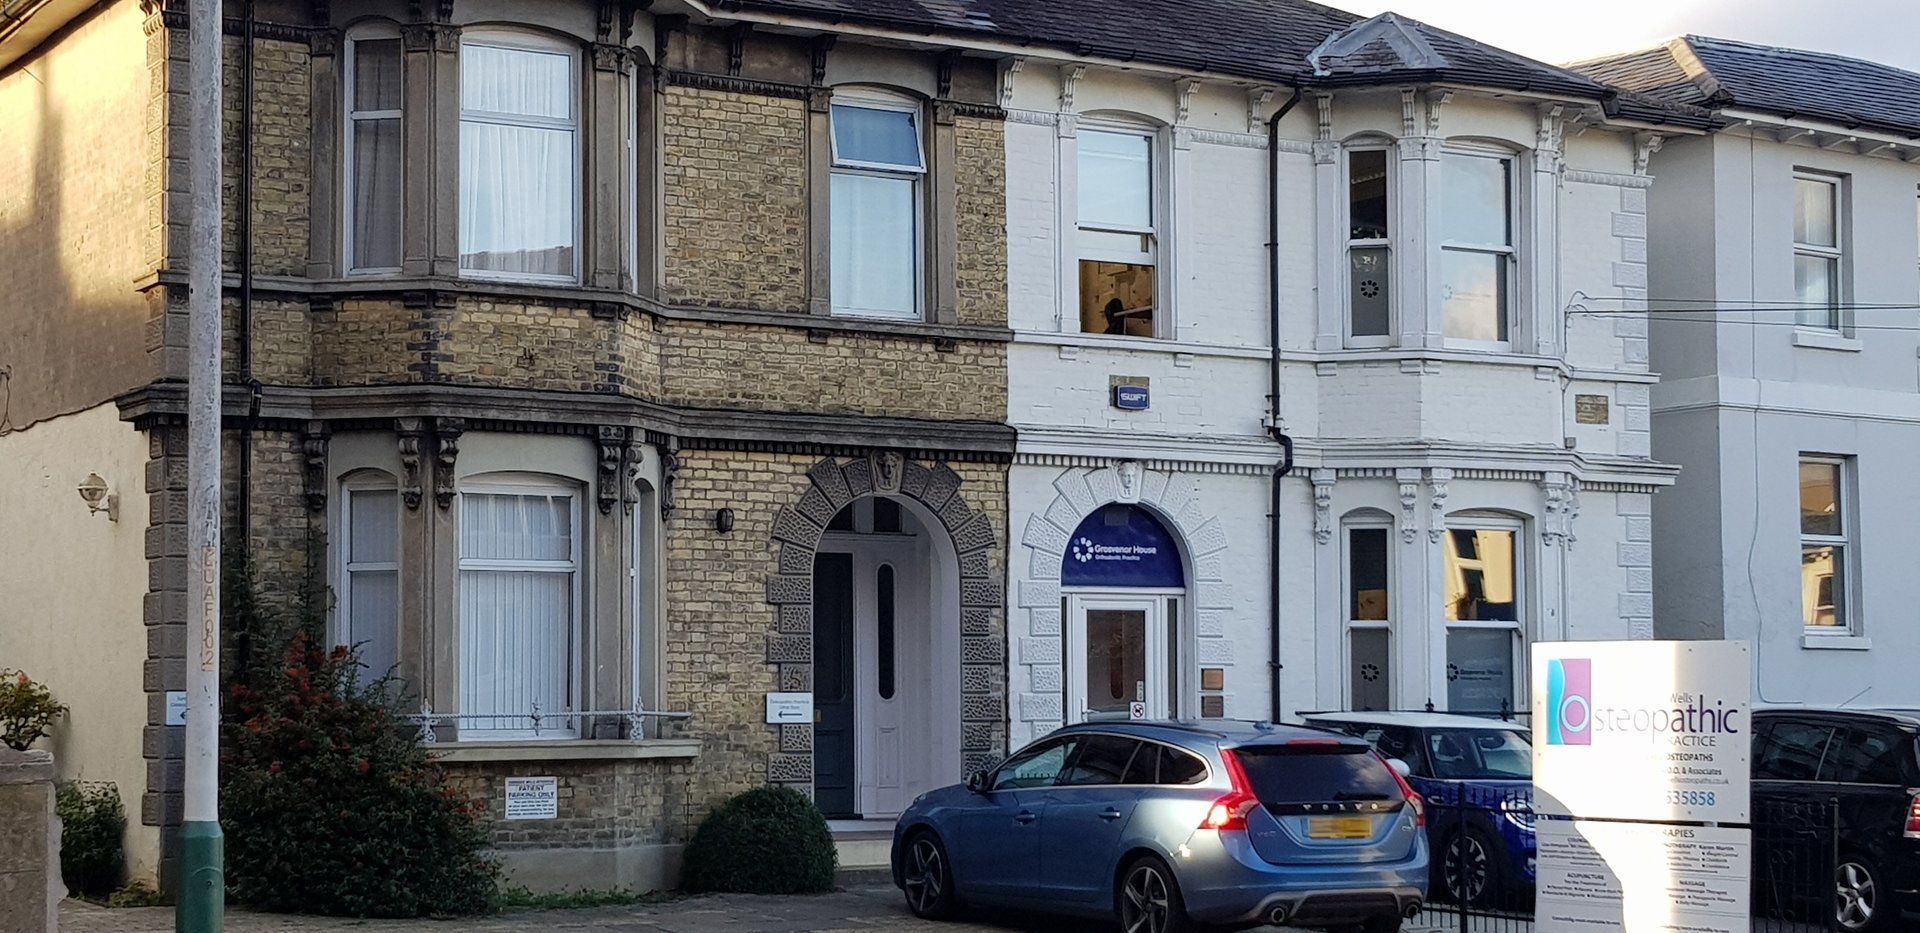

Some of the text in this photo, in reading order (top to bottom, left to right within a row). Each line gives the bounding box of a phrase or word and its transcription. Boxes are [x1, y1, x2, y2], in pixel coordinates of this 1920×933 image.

[1094, 544, 1157, 555] Grosvenor House
[1561, 694, 1738, 745] Osteopathic
[1303, 803, 1378, 811] VOLVO
